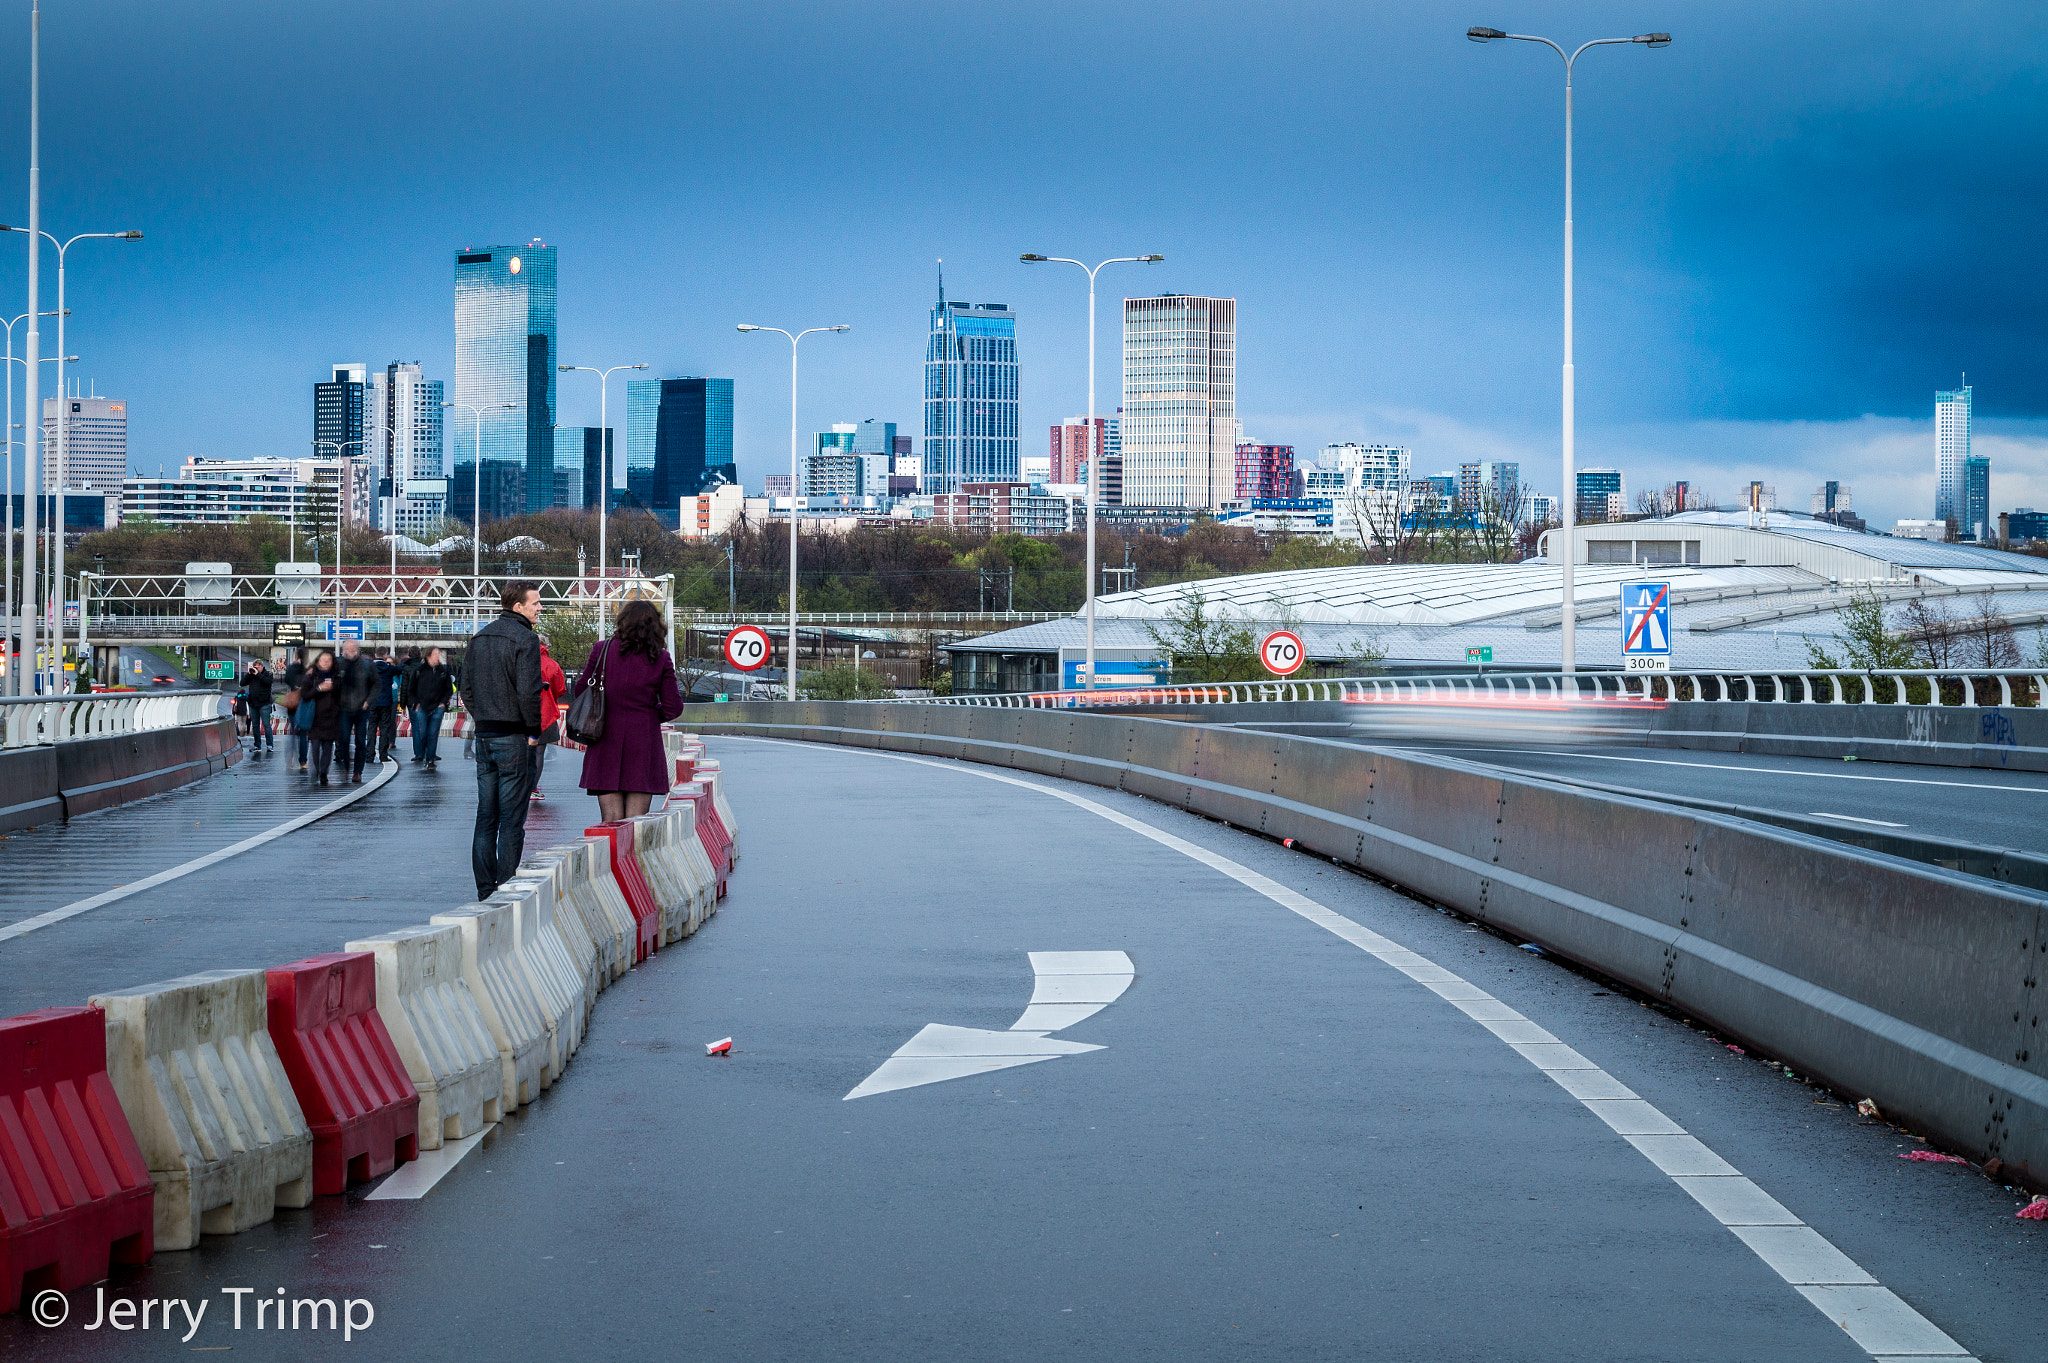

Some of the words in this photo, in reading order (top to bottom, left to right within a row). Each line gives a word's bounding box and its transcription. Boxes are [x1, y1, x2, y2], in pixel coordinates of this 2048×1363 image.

[734, 640, 762, 657] 70
[1269, 644, 1297, 661] 70
[207, 670, 223, 678] 19,6
